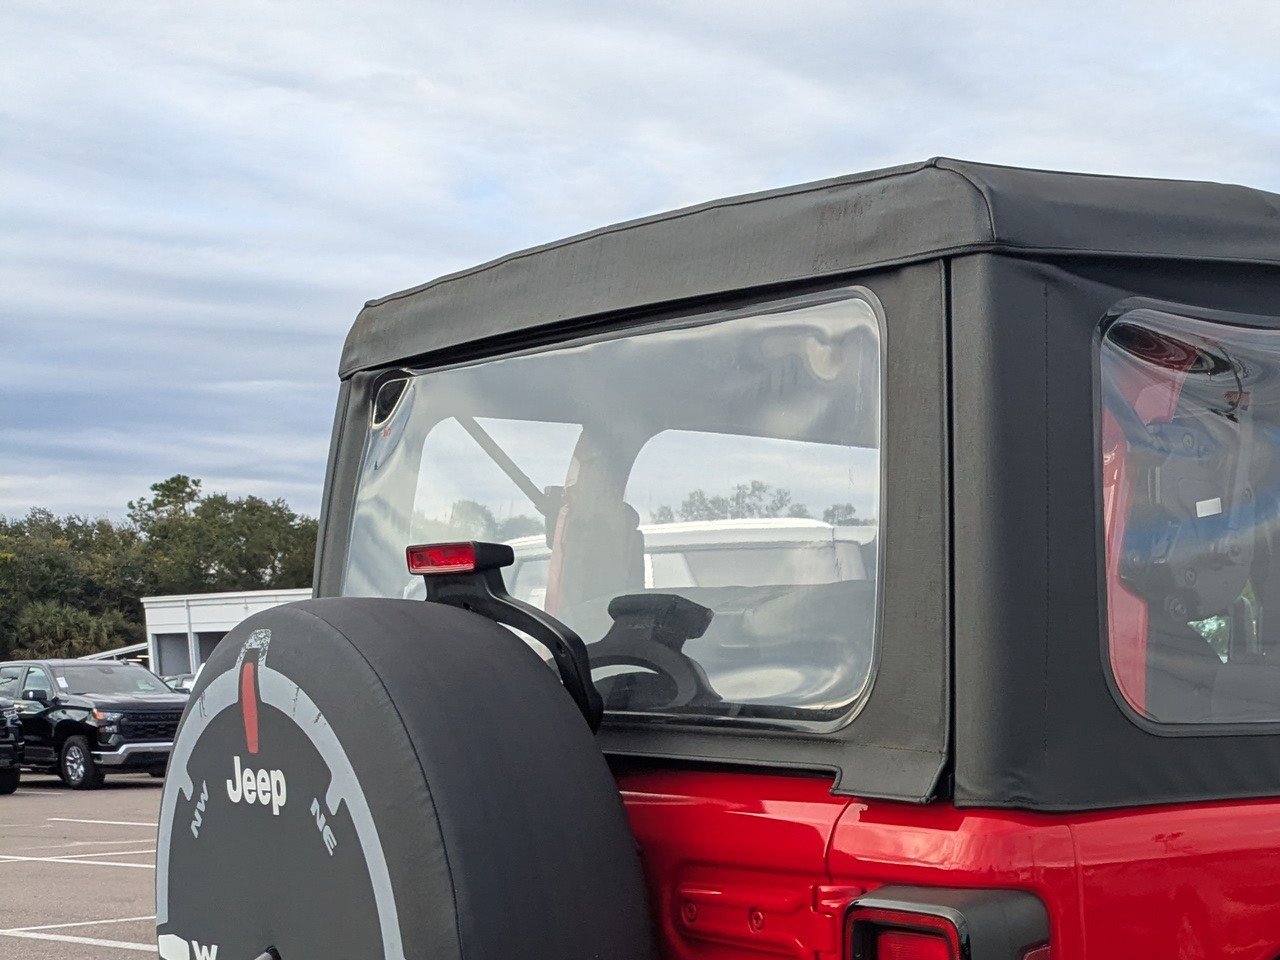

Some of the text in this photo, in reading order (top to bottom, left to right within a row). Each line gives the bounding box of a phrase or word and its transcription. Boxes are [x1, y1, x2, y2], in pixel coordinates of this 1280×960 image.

[190, 779, 209, 839] NW
[226, 755, 288, 816] Jeep
[310, 797, 338, 856] NE
